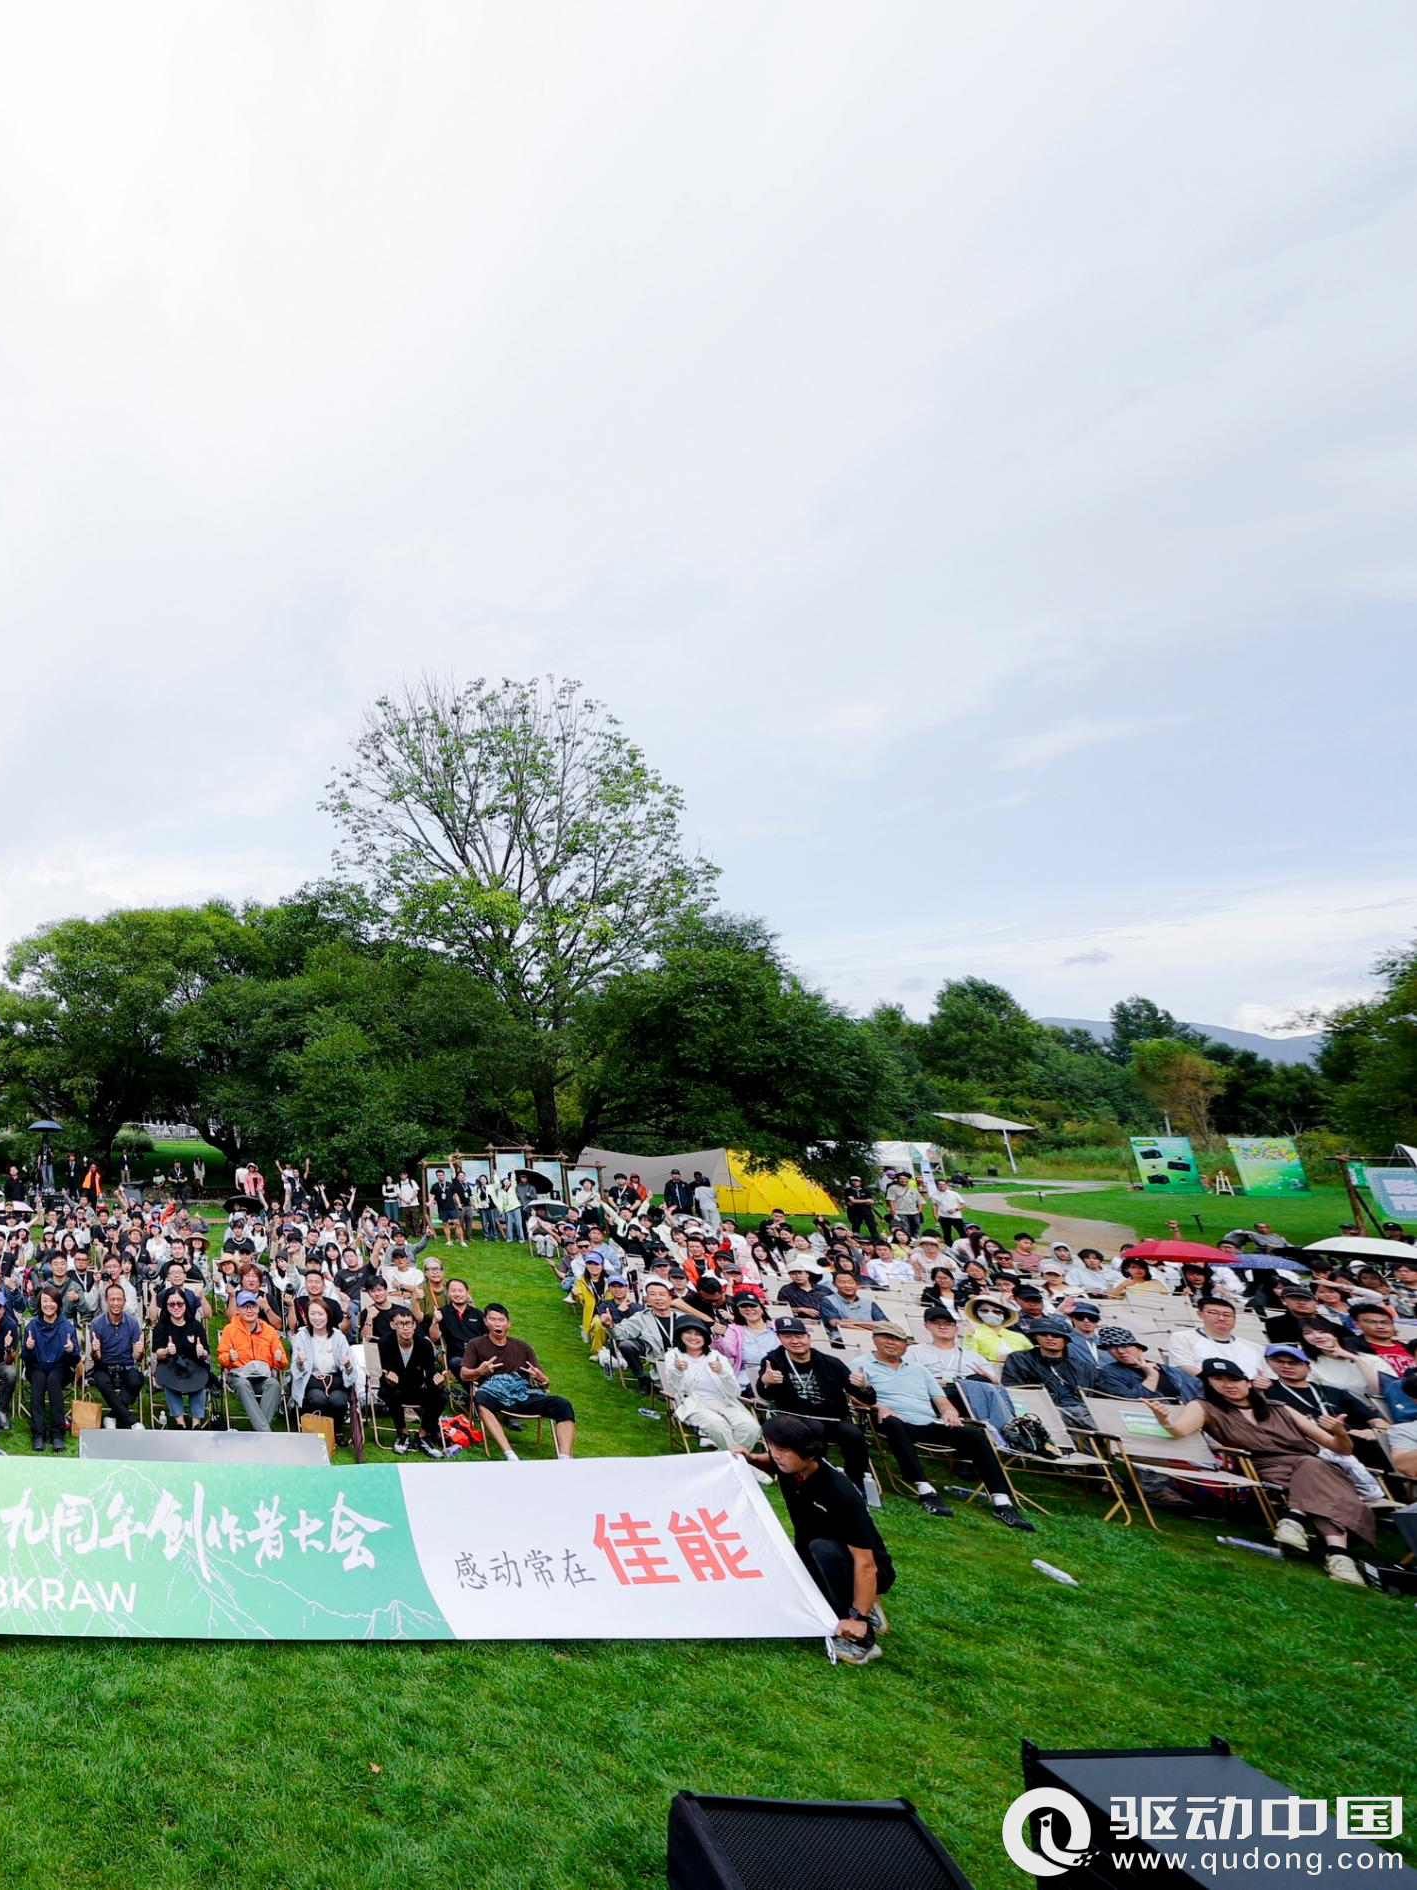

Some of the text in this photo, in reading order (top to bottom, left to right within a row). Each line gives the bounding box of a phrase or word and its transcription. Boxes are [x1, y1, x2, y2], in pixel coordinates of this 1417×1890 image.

[0, 1481, 394, 1582] 九周年创作者大会
[453, 1508, 764, 1590] 感动常在 佳能
